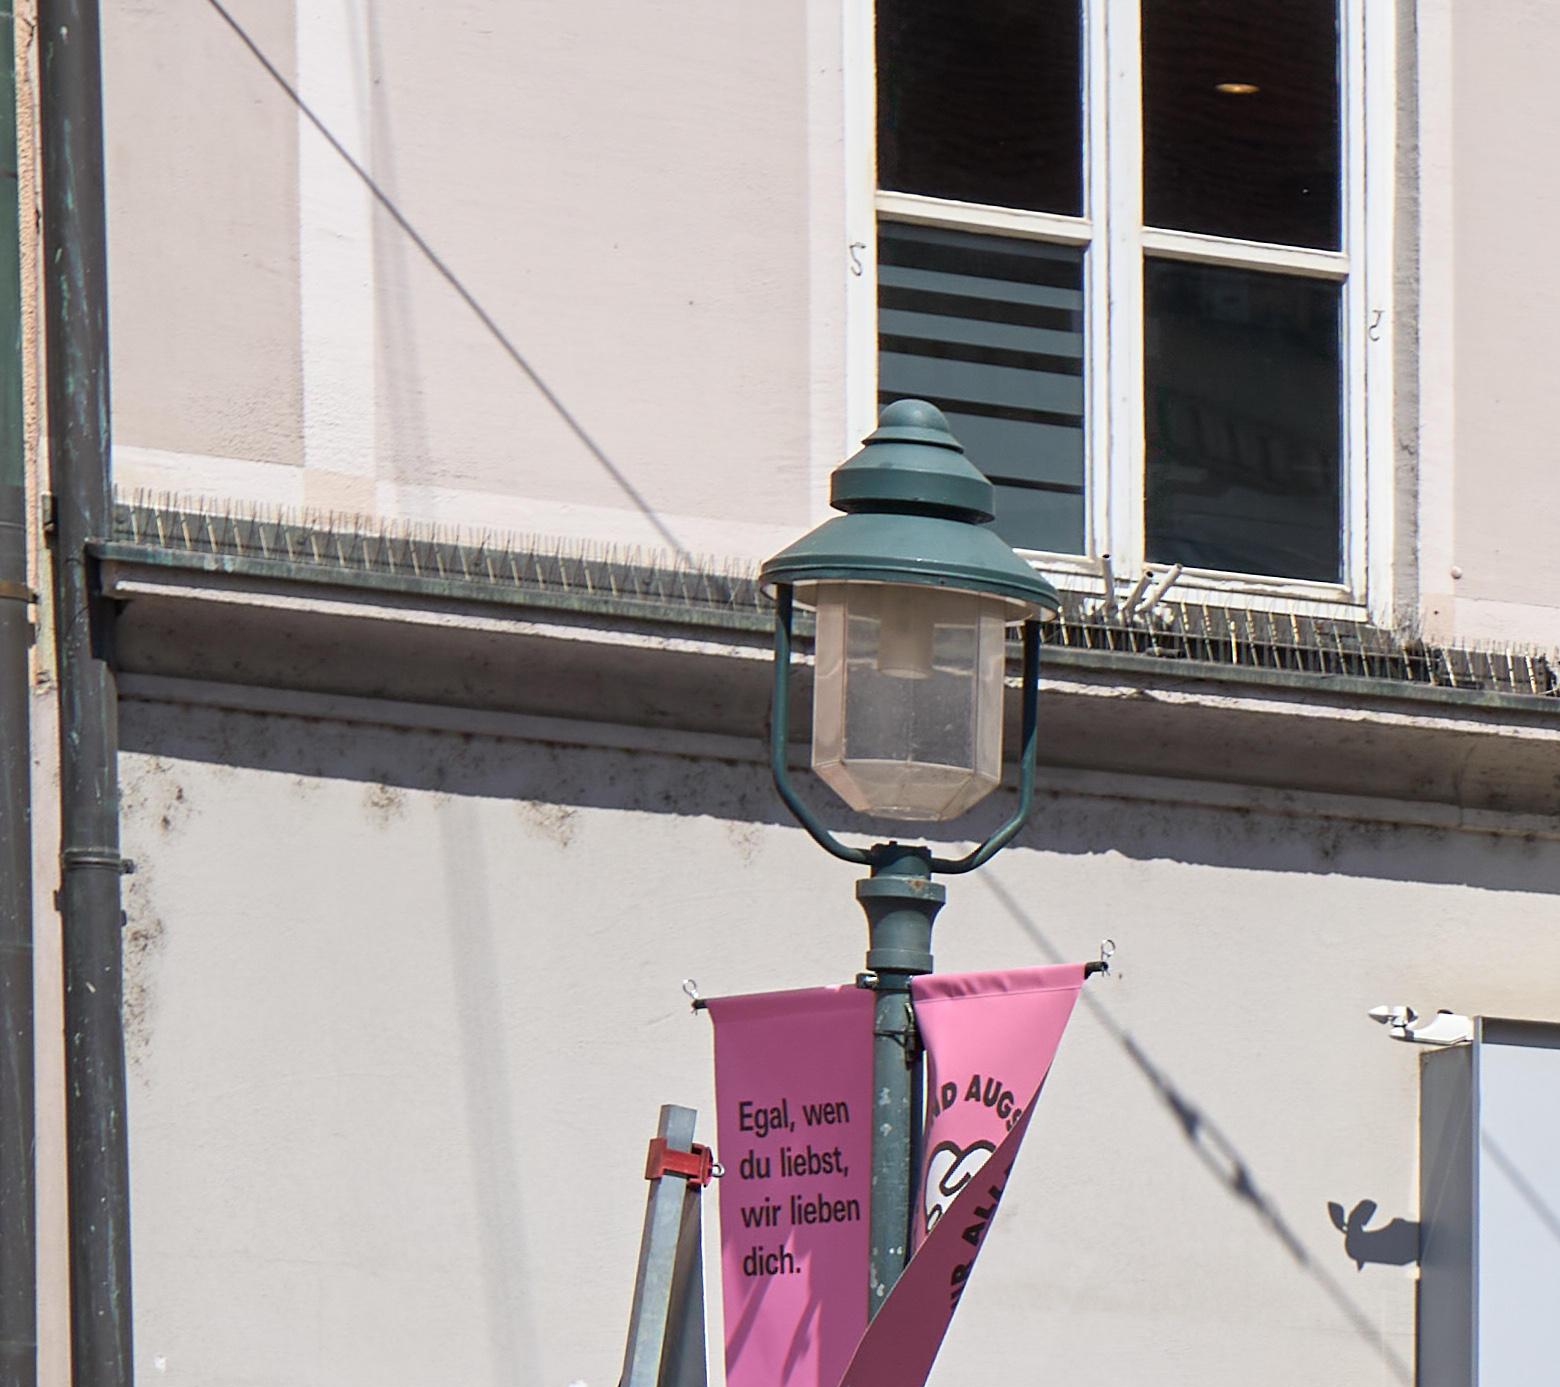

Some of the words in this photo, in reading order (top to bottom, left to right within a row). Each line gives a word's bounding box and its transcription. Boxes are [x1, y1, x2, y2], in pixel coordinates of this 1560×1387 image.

[739, 1098, 795, 1137] Egal,
[803, 1101, 850, 1126] wen
[740, 1150, 771, 1179] du
[781, 1145, 849, 1177] liebst,
[741, 1197, 782, 1228] wir
[790, 1194, 861, 1225] lieben
[743, 1245, 801, 1276] dich.
